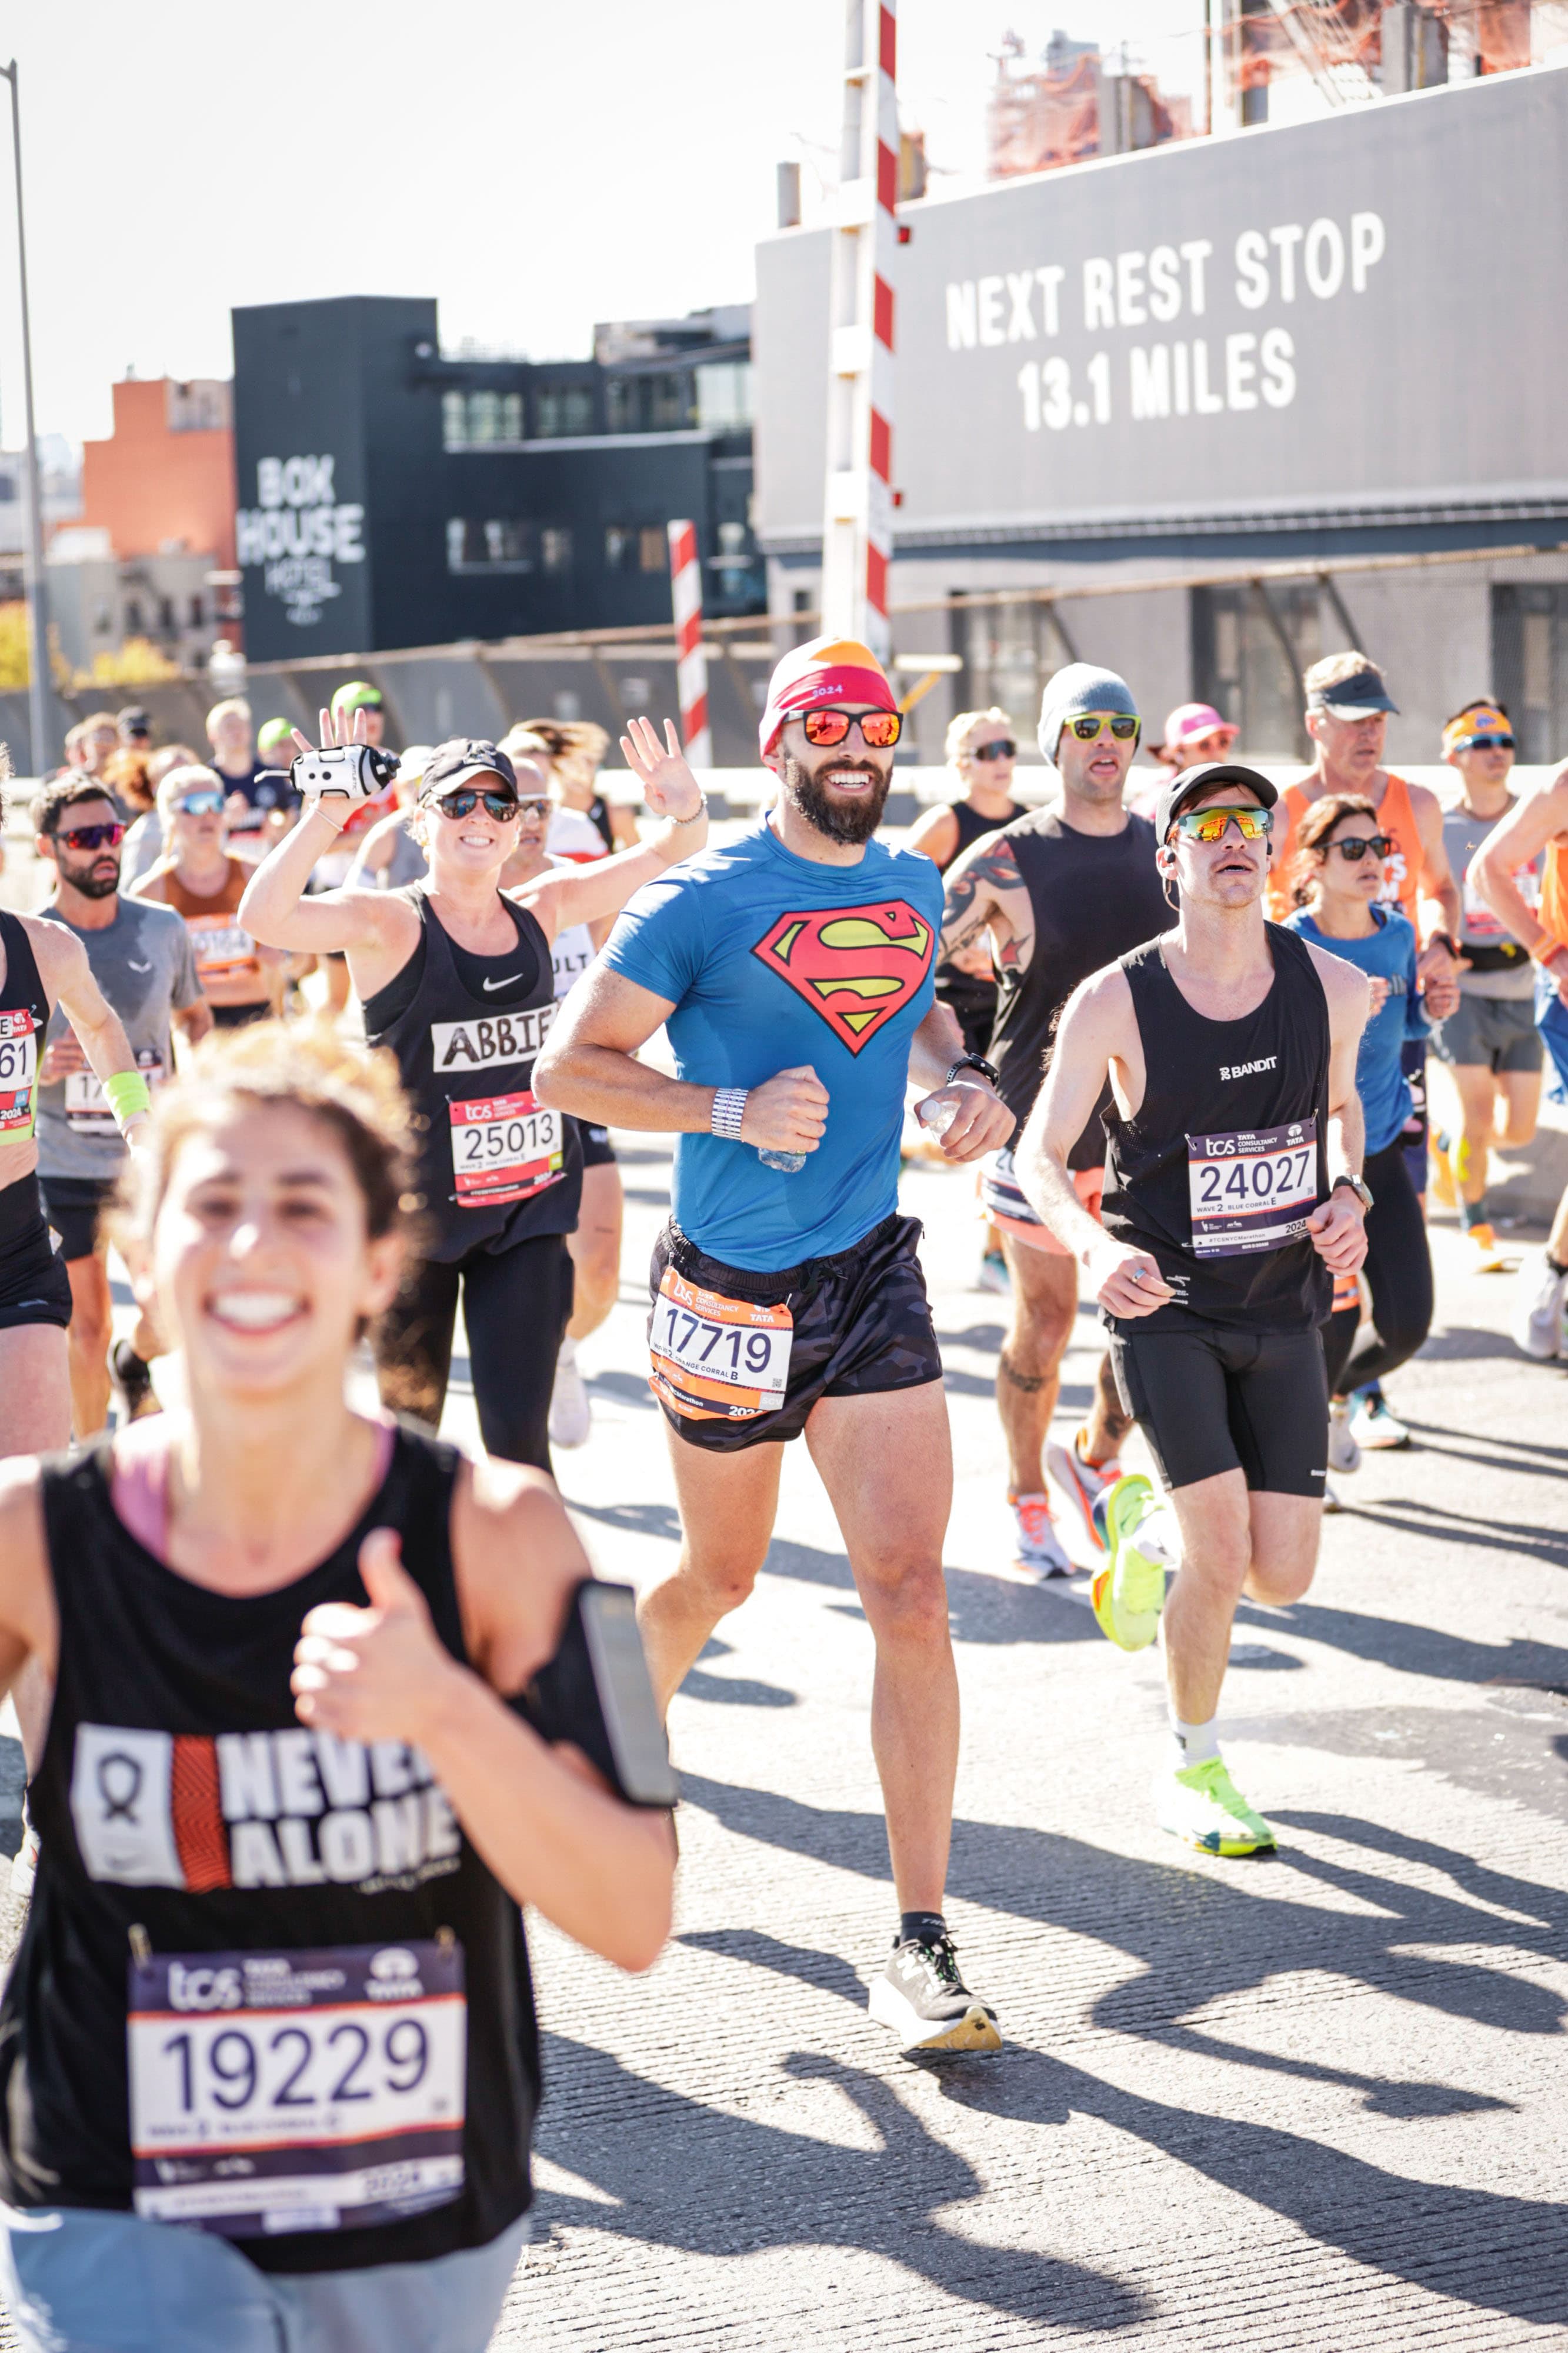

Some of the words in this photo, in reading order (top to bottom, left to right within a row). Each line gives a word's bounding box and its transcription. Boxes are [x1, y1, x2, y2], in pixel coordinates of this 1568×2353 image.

[946, 265, 1066, 350] NEXT
[1083, 238, 1212, 331] REST
[1235, 211, 1385, 309] STOP
[1017, 352, 1111, 431] 13.1
[1131, 327, 1296, 421] MILES
[257, 454, 335, 508] BOX
[236, 503, 366, 566] HOUSE
[813, 684, 843, 698] 2024
[442, 1008, 552, 1066] ABBIE
[1231, 1056, 1277, 1078] BANDIT
[0, 1107, 22, 1120] 2024
[465, 1104, 492, 1121] tcs
[465, 1114, 553, 1160] 25013
[1206, 1138, 1235, 1156] tcs
[1237, 1137, 1277, 1147] CONSULTANCY
[1286, 1136, 1304, 1146] TATA
[1200, 1150, 1310, 1203] 24027
[1209, 1233, 1266, 1243] #TCSNYCMarathon
[1286, 1219, 1306, 1234] 2024
[694, 1304, 721, 1317] SERVICES
[696, 1297, 739, 1312] CONSULTANCY
[750, 1313, 774, 1323] TATA
[667, 1308, 771, 1374] 17719
[668, 1349, 673, 1358] 2
[700, 1365, 729, 1378] CORRAL
[730, 1371, 738, 1381] B
[215, 1729, 436, 1821] NEVE
[229, 1791, 461, 1888] ALONE
[168, 1961, 242, 2011] tcs
[164, 2018, 428, 2113] 19229
